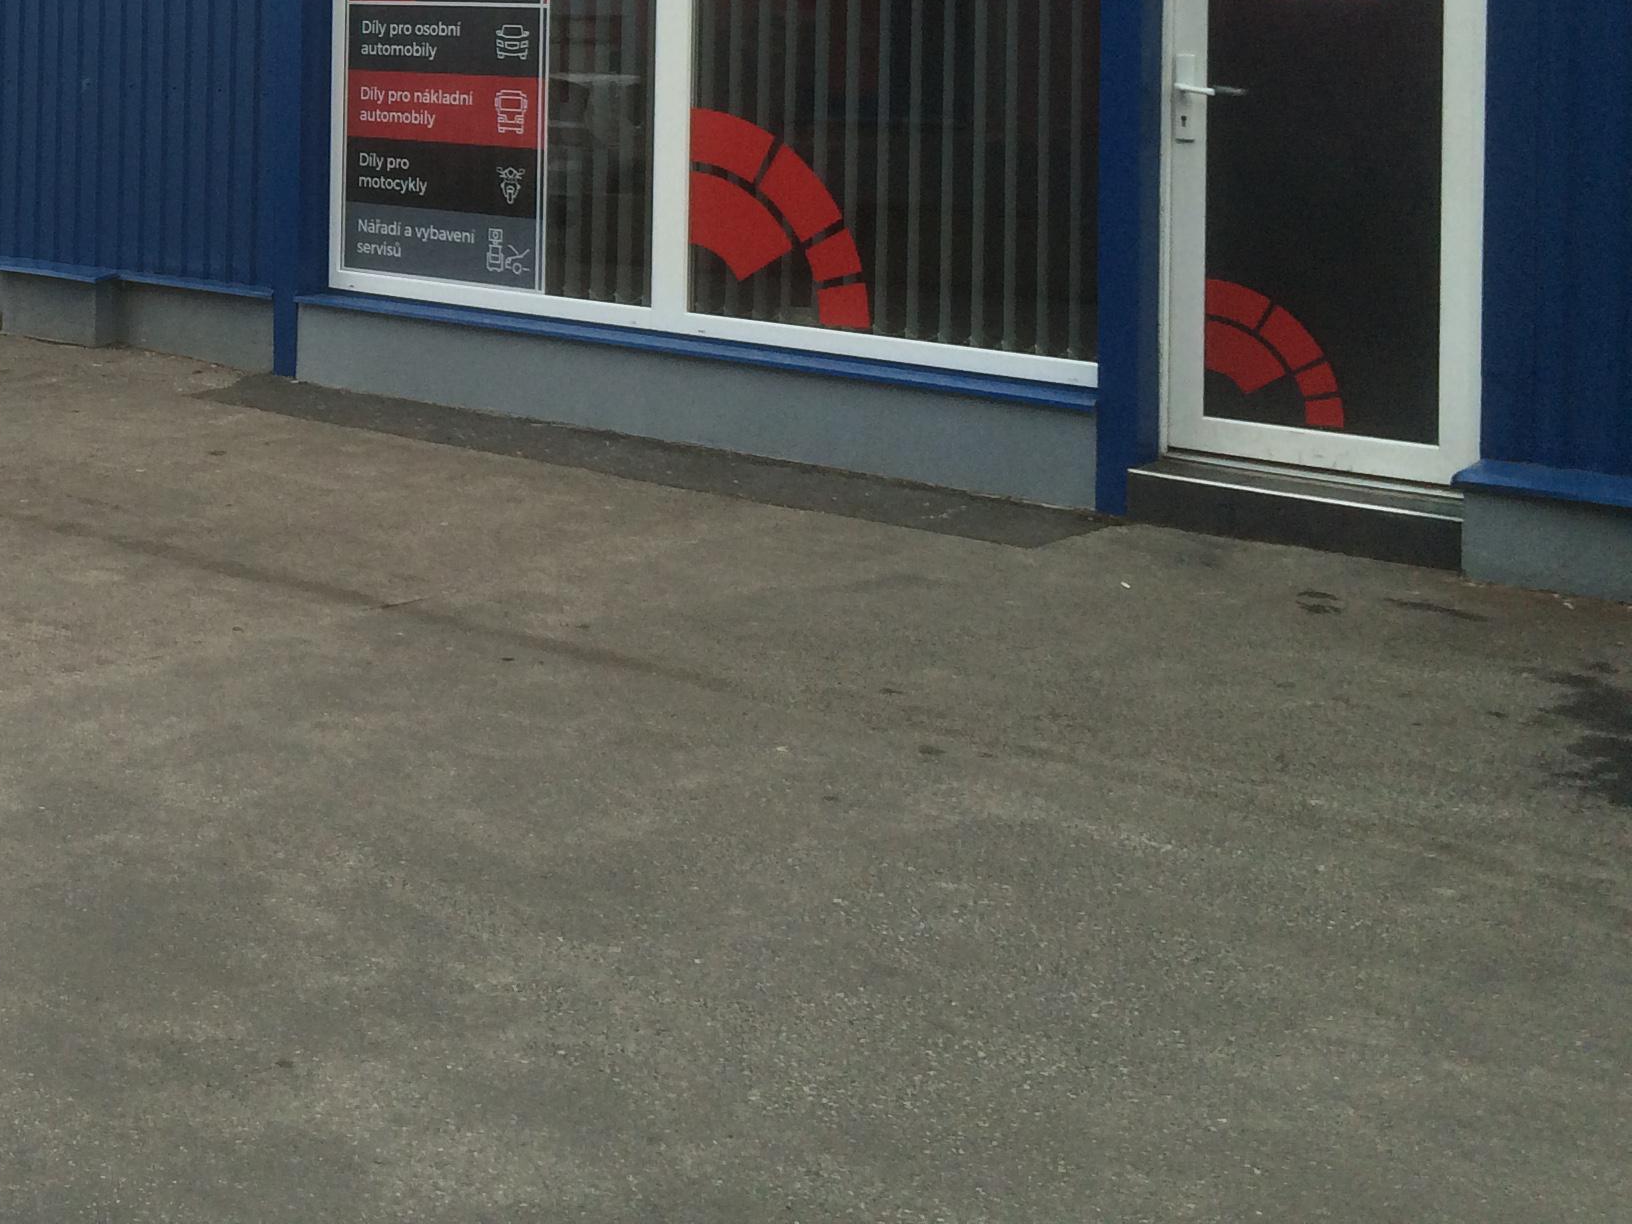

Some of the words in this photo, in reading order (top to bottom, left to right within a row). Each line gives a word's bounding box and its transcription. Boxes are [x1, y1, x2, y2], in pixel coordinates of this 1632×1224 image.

[361, 20, 386, 37] Díly
[389, 24, 411, 38] pro
[414, 22, 462, 37] osobní
[361, 43, 437, 60] automobily
[360, 86, 385, 105] Díly
[387, 90, 411, 105] pro
[413, 90, 474, 105] nákladní
[359, 108, 436, 128] automobily
[359, 152, 384, 171] Díly
[386, 156, 410, 171] pro
[358, 176, 428, 196] motocykly
[357, 219, 402, 237] Nářadí
[404, 225, 412, 237] a
[356, 241, 402, 258] servisů
